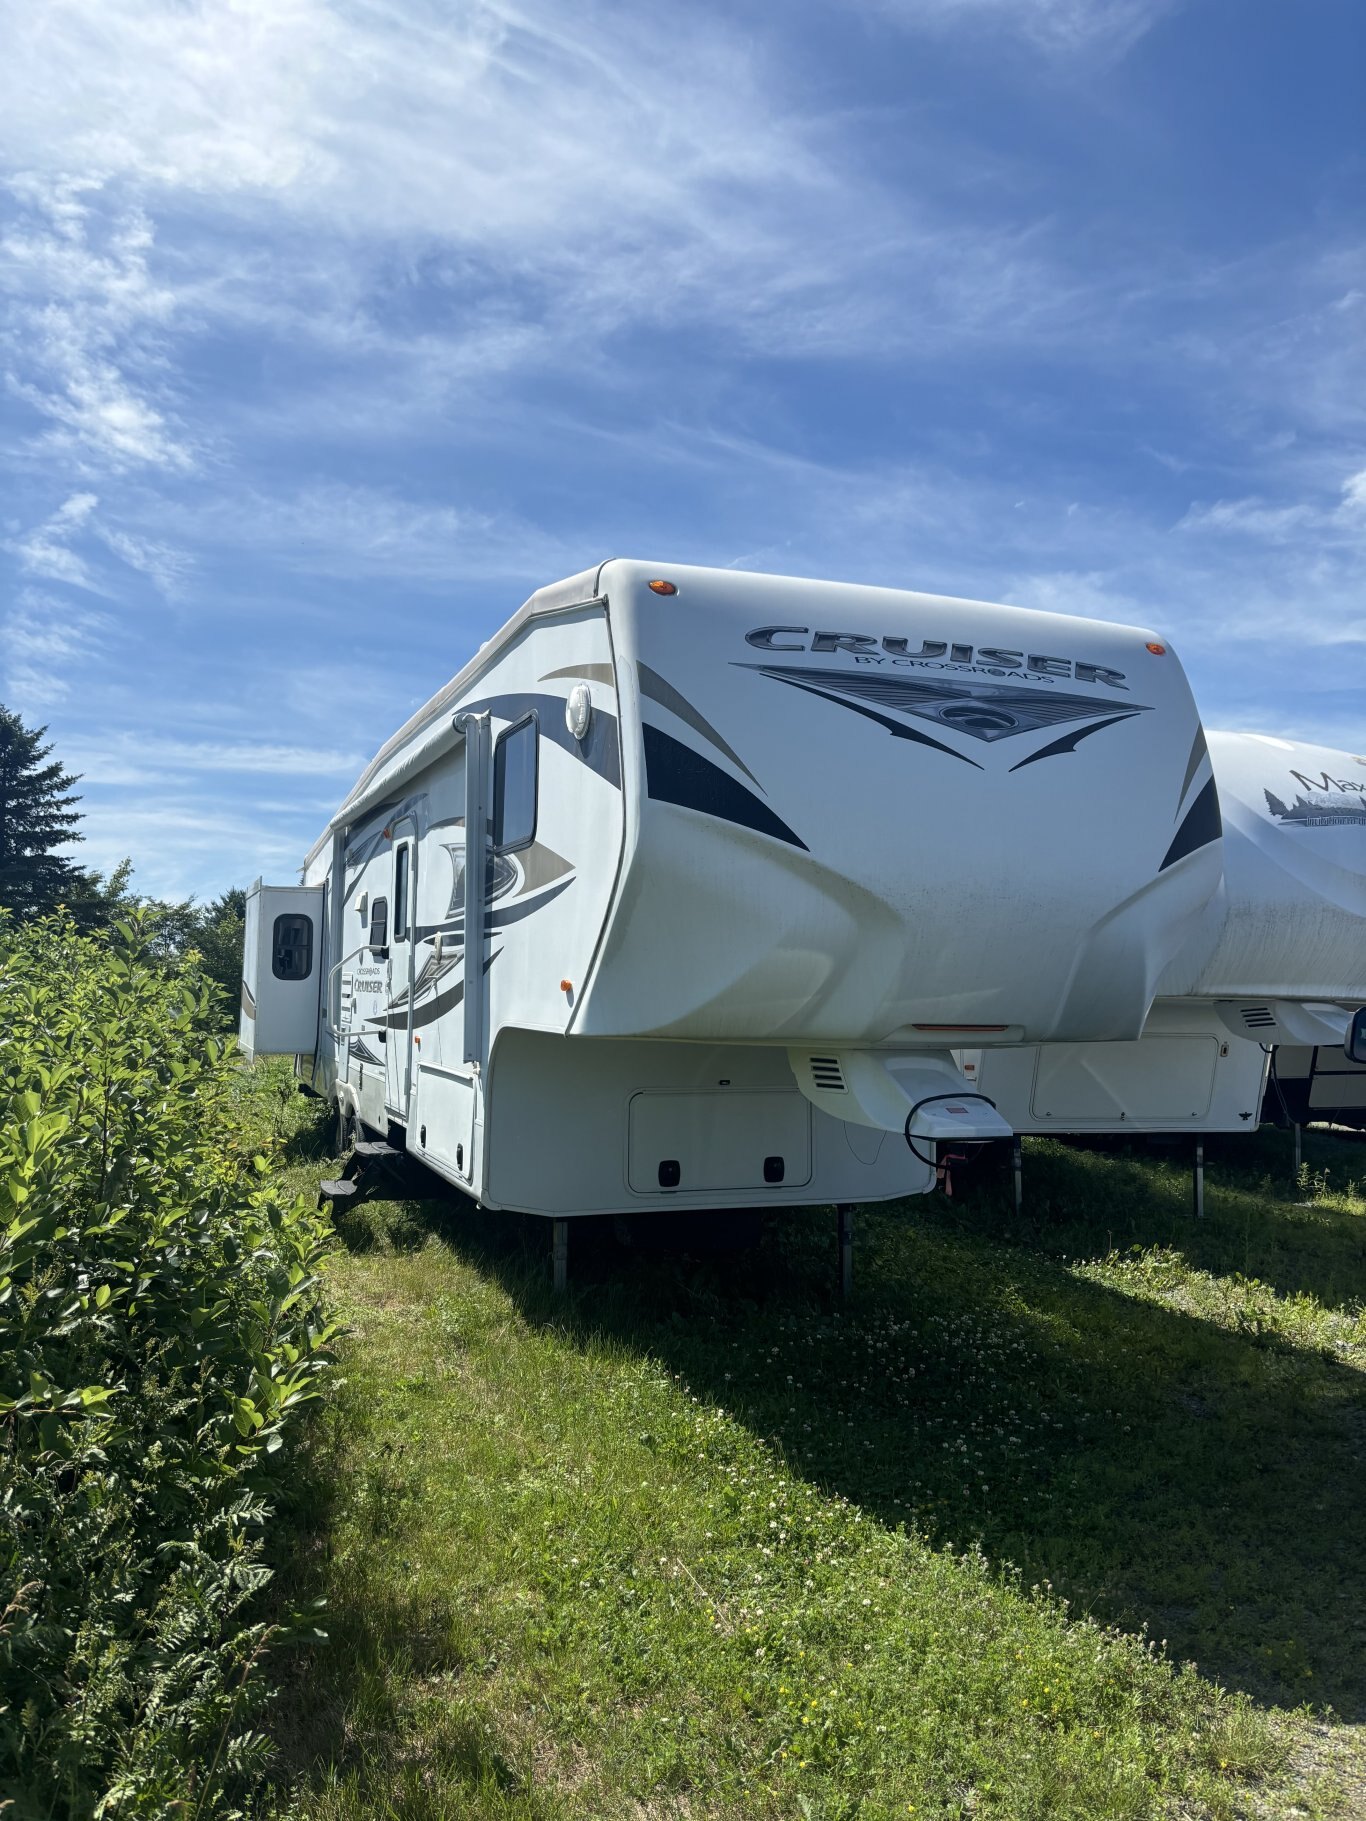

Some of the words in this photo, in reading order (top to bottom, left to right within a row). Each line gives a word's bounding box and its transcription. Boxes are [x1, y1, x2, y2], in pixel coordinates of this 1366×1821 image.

[744, 625, 1129, 690] CRUISER
[854, 656, 886, 665] BY
[891, 659, 1055, 684] CROSSROADS
[354, 978, 383, 994] CRUISER
